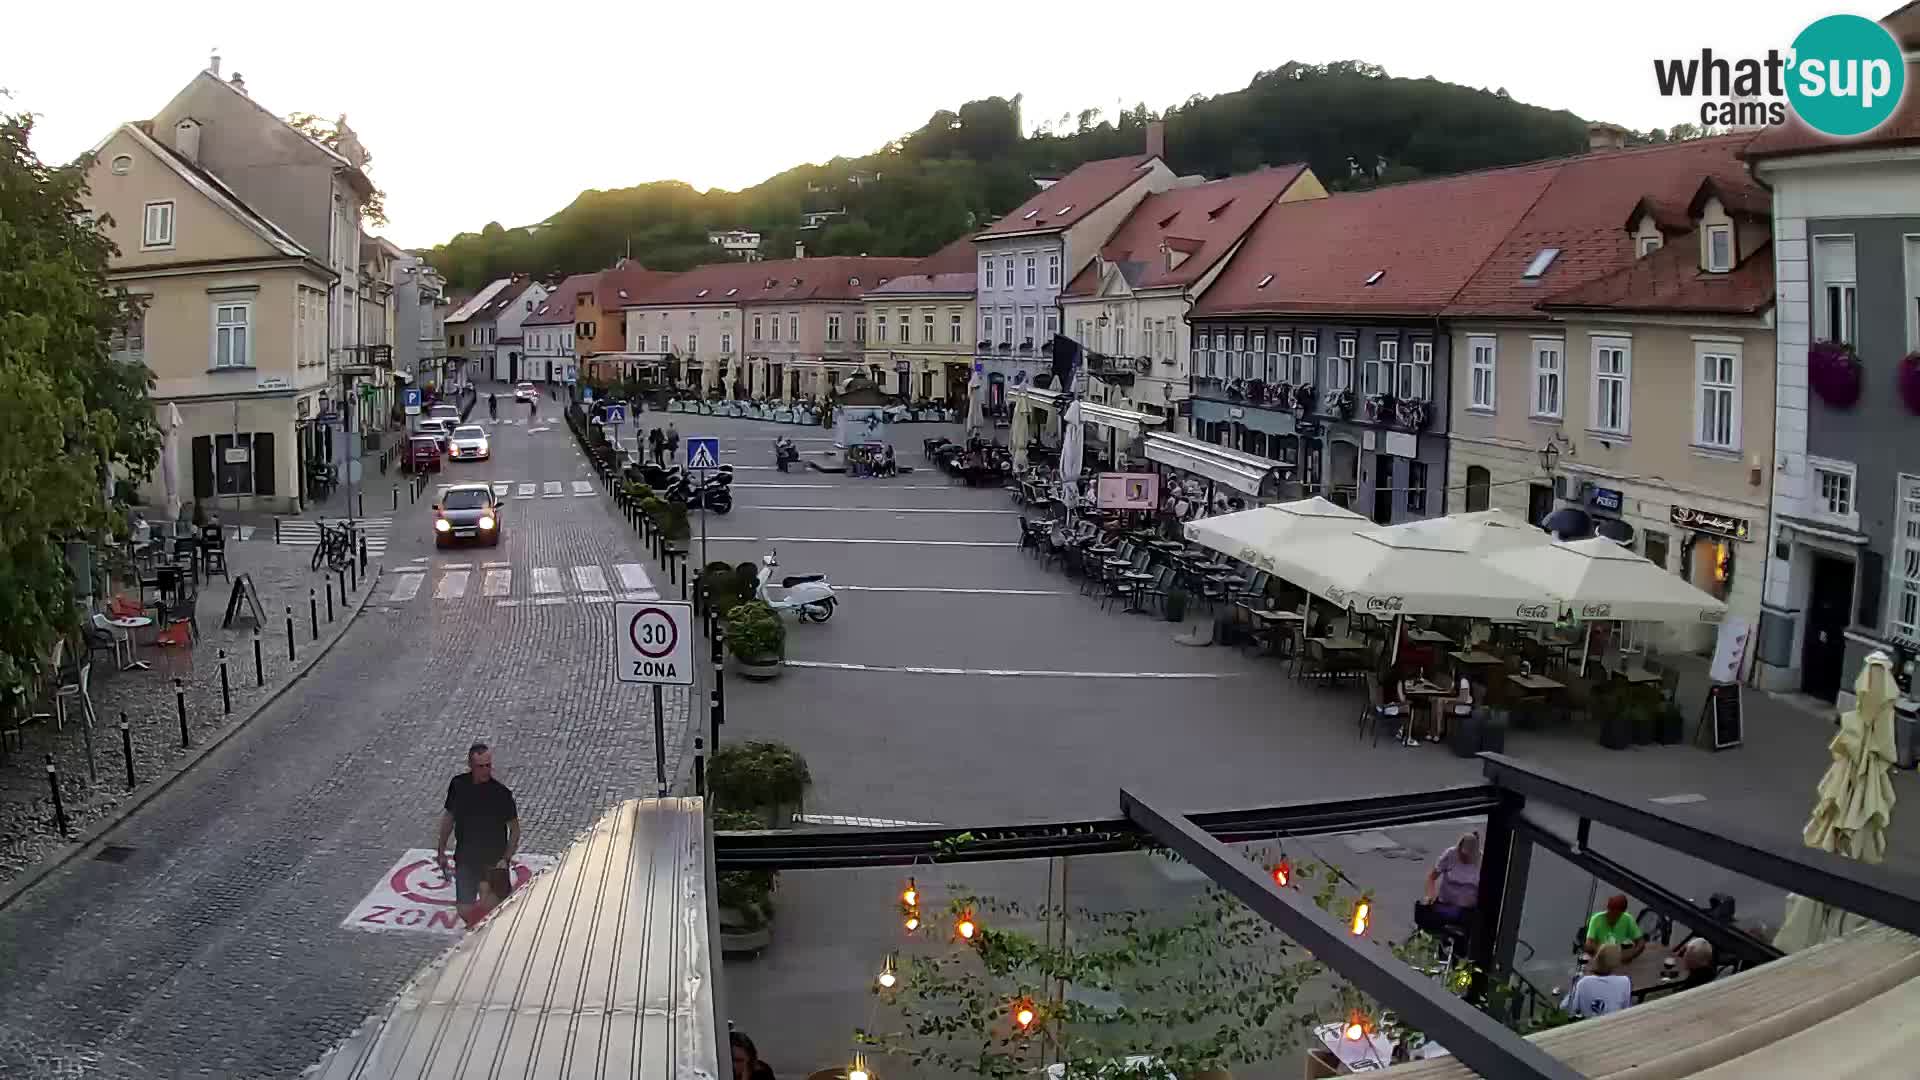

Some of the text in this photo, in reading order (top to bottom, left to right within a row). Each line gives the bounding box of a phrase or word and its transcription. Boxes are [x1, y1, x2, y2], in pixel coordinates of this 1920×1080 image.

[409, 392, 416, 404] P
[643, 624, 666, 644] 30
[633, 661, 677, 677] ZONA
[359, 905, 458, 929] ZON
